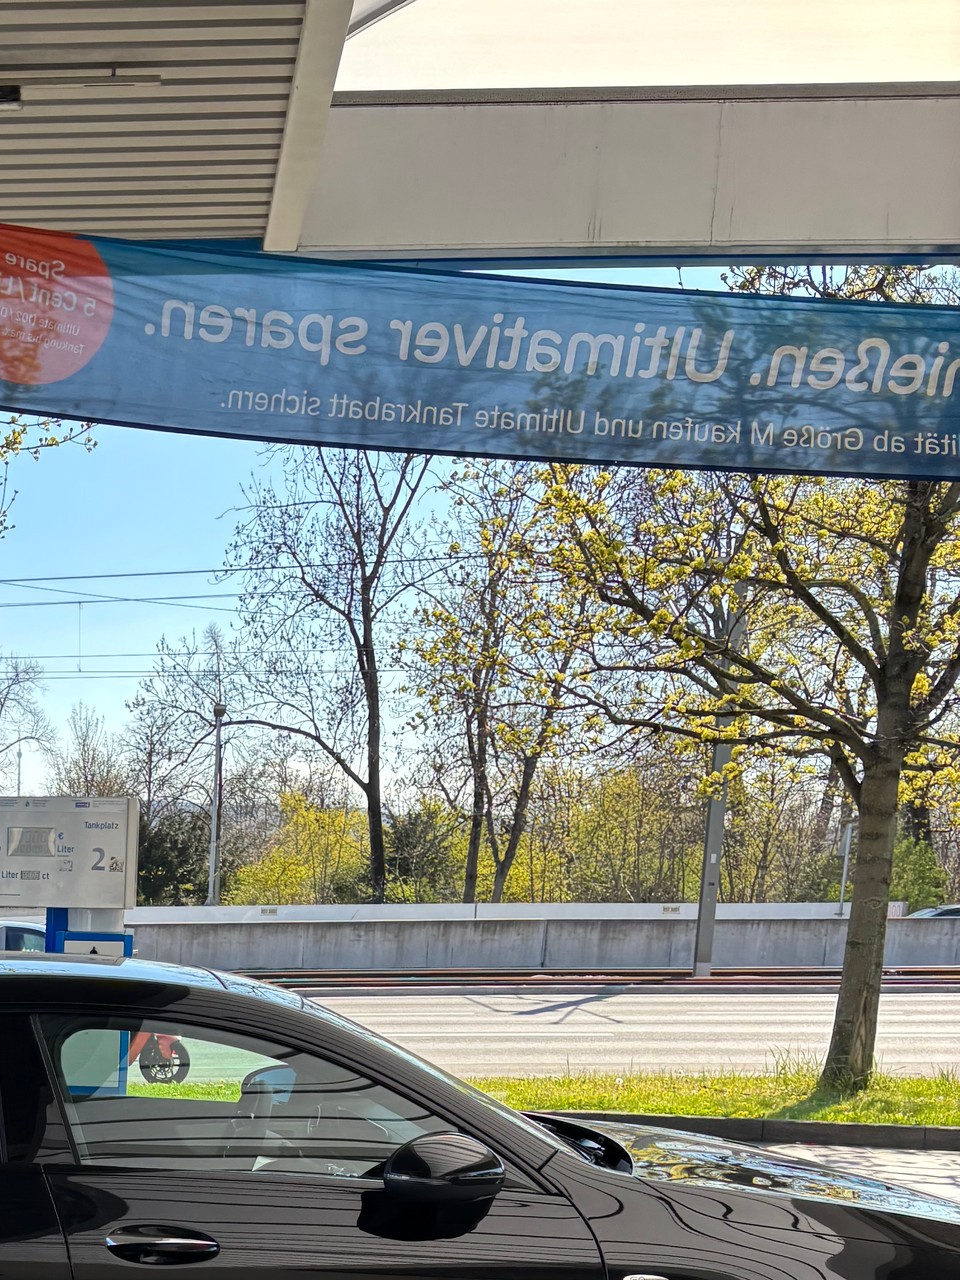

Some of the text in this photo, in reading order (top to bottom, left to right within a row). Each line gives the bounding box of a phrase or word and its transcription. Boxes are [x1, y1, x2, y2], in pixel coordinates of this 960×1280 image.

[84, 821, 119, 830] Tankplatz
[58, 832, 64, 840] €
[57, 844, 75, 853] Liter
[91, 847, 106, 871] 2
[1, 871, 20, 879] Liter
[41, 872, 50, 880] ct
